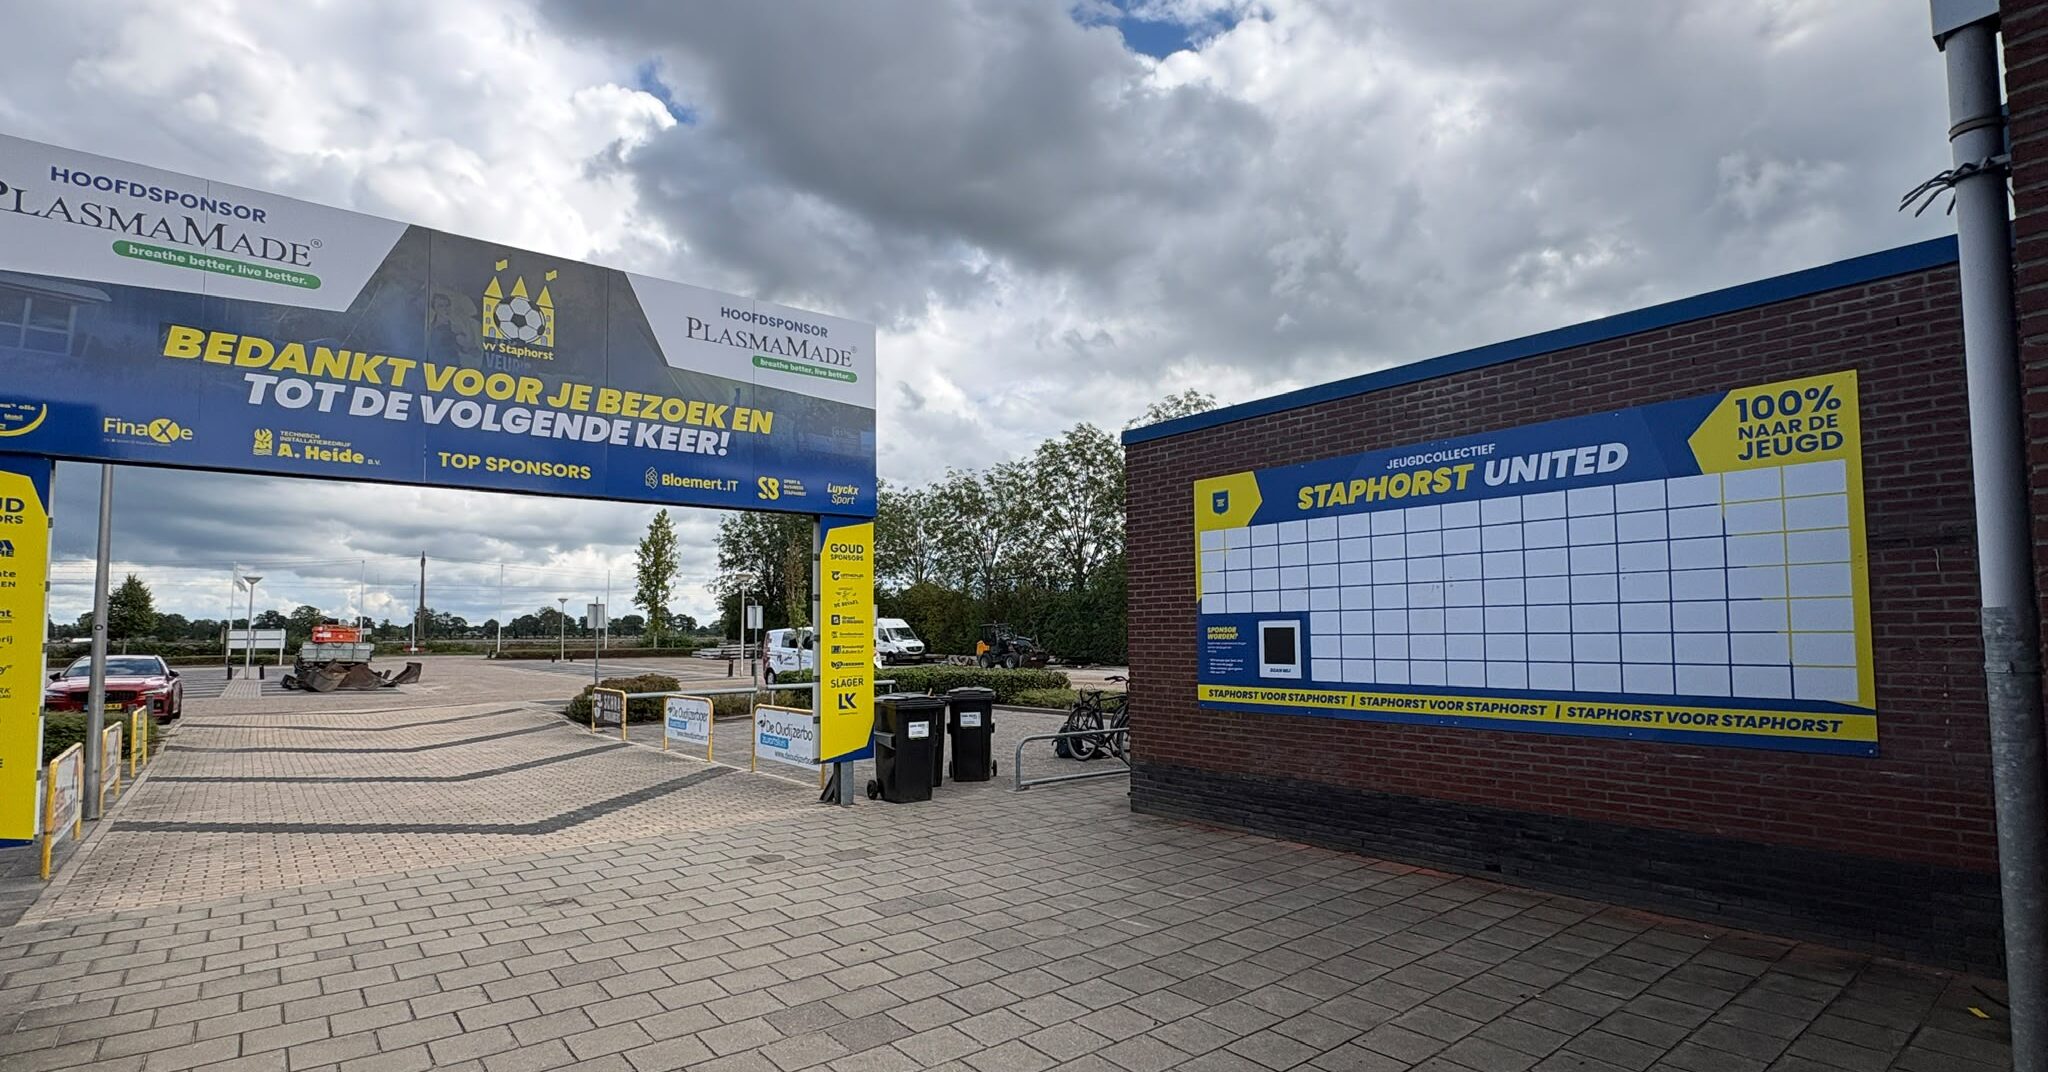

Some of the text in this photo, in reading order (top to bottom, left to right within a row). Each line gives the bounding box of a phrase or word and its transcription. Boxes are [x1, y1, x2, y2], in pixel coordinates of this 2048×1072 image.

[50, 166, 266, 224] HOOFDSPONSOR
[129, 244, 308, 285] breathe better, live better.
[721, 306, 829, 338] HOOFDSPONSOR
[499, 343, 554, 361] Staphorst
[760, 358, 789, 370] breathe
[814, 367, 828, 376] live
[163, 325, 774, 434] BEDANKT VOOR JE BEZOEK EN
[243, 373, 731, 456] TOT DE VOLGENDE KEER!
[1735, 385, 1842, 423] 100%
[280, 430, 320, 439] TECHNISCH
[1738, 413, 1839, 441] NAAR DE
[280, 437, 351, 447] INSTALLATIEBEDRIJF
[1738, 430, 1844, 461] JEUGD
[277, 443, 300, 459] A.
[305, 445, 365, 464] Heide
[1386, 443, 1496, 470] JEUGDCOLLECTIEF
[438, 452, 592, 480] TOP SPONSORS
[1297, 442, 1629, 511] STAPHORST UNITED
[661, 474, 738, 493] Bloemert.IT
[827, 482, 860, 496] Luyckx
[831, 493, 855, 505] Sport
[830, 543, 864, 555] GOUD
[830, 553, 864, 562] SPONSORS
[1207, 626, 1237, 634] SPONSOR
[1207, 632, 1239, 640] WORDEN?
[830, 677, 864, 689] SLAGER
[838, 692, 857, 710] LK
[1208, 688, 1259, 700] STAPHORST
[1260, 691, 1287, 702] VOOR
[1288, 694, 1348, 705] STAPHORST
[1359, 696, 1427, 709] STAPHORST
[1429, 699, 1463, 711] VOOR
[1466, 701, 1548, 716] STAPHORST
[1567, 706, 1663, 723] STAPHORST
[1666, 711, 1719, 727] VOOR
[1721, 714, 1843, 733] STAPHORST
[766, 720, 775, 733] De
[775, 721, 813, 742] Oudijzerbo
